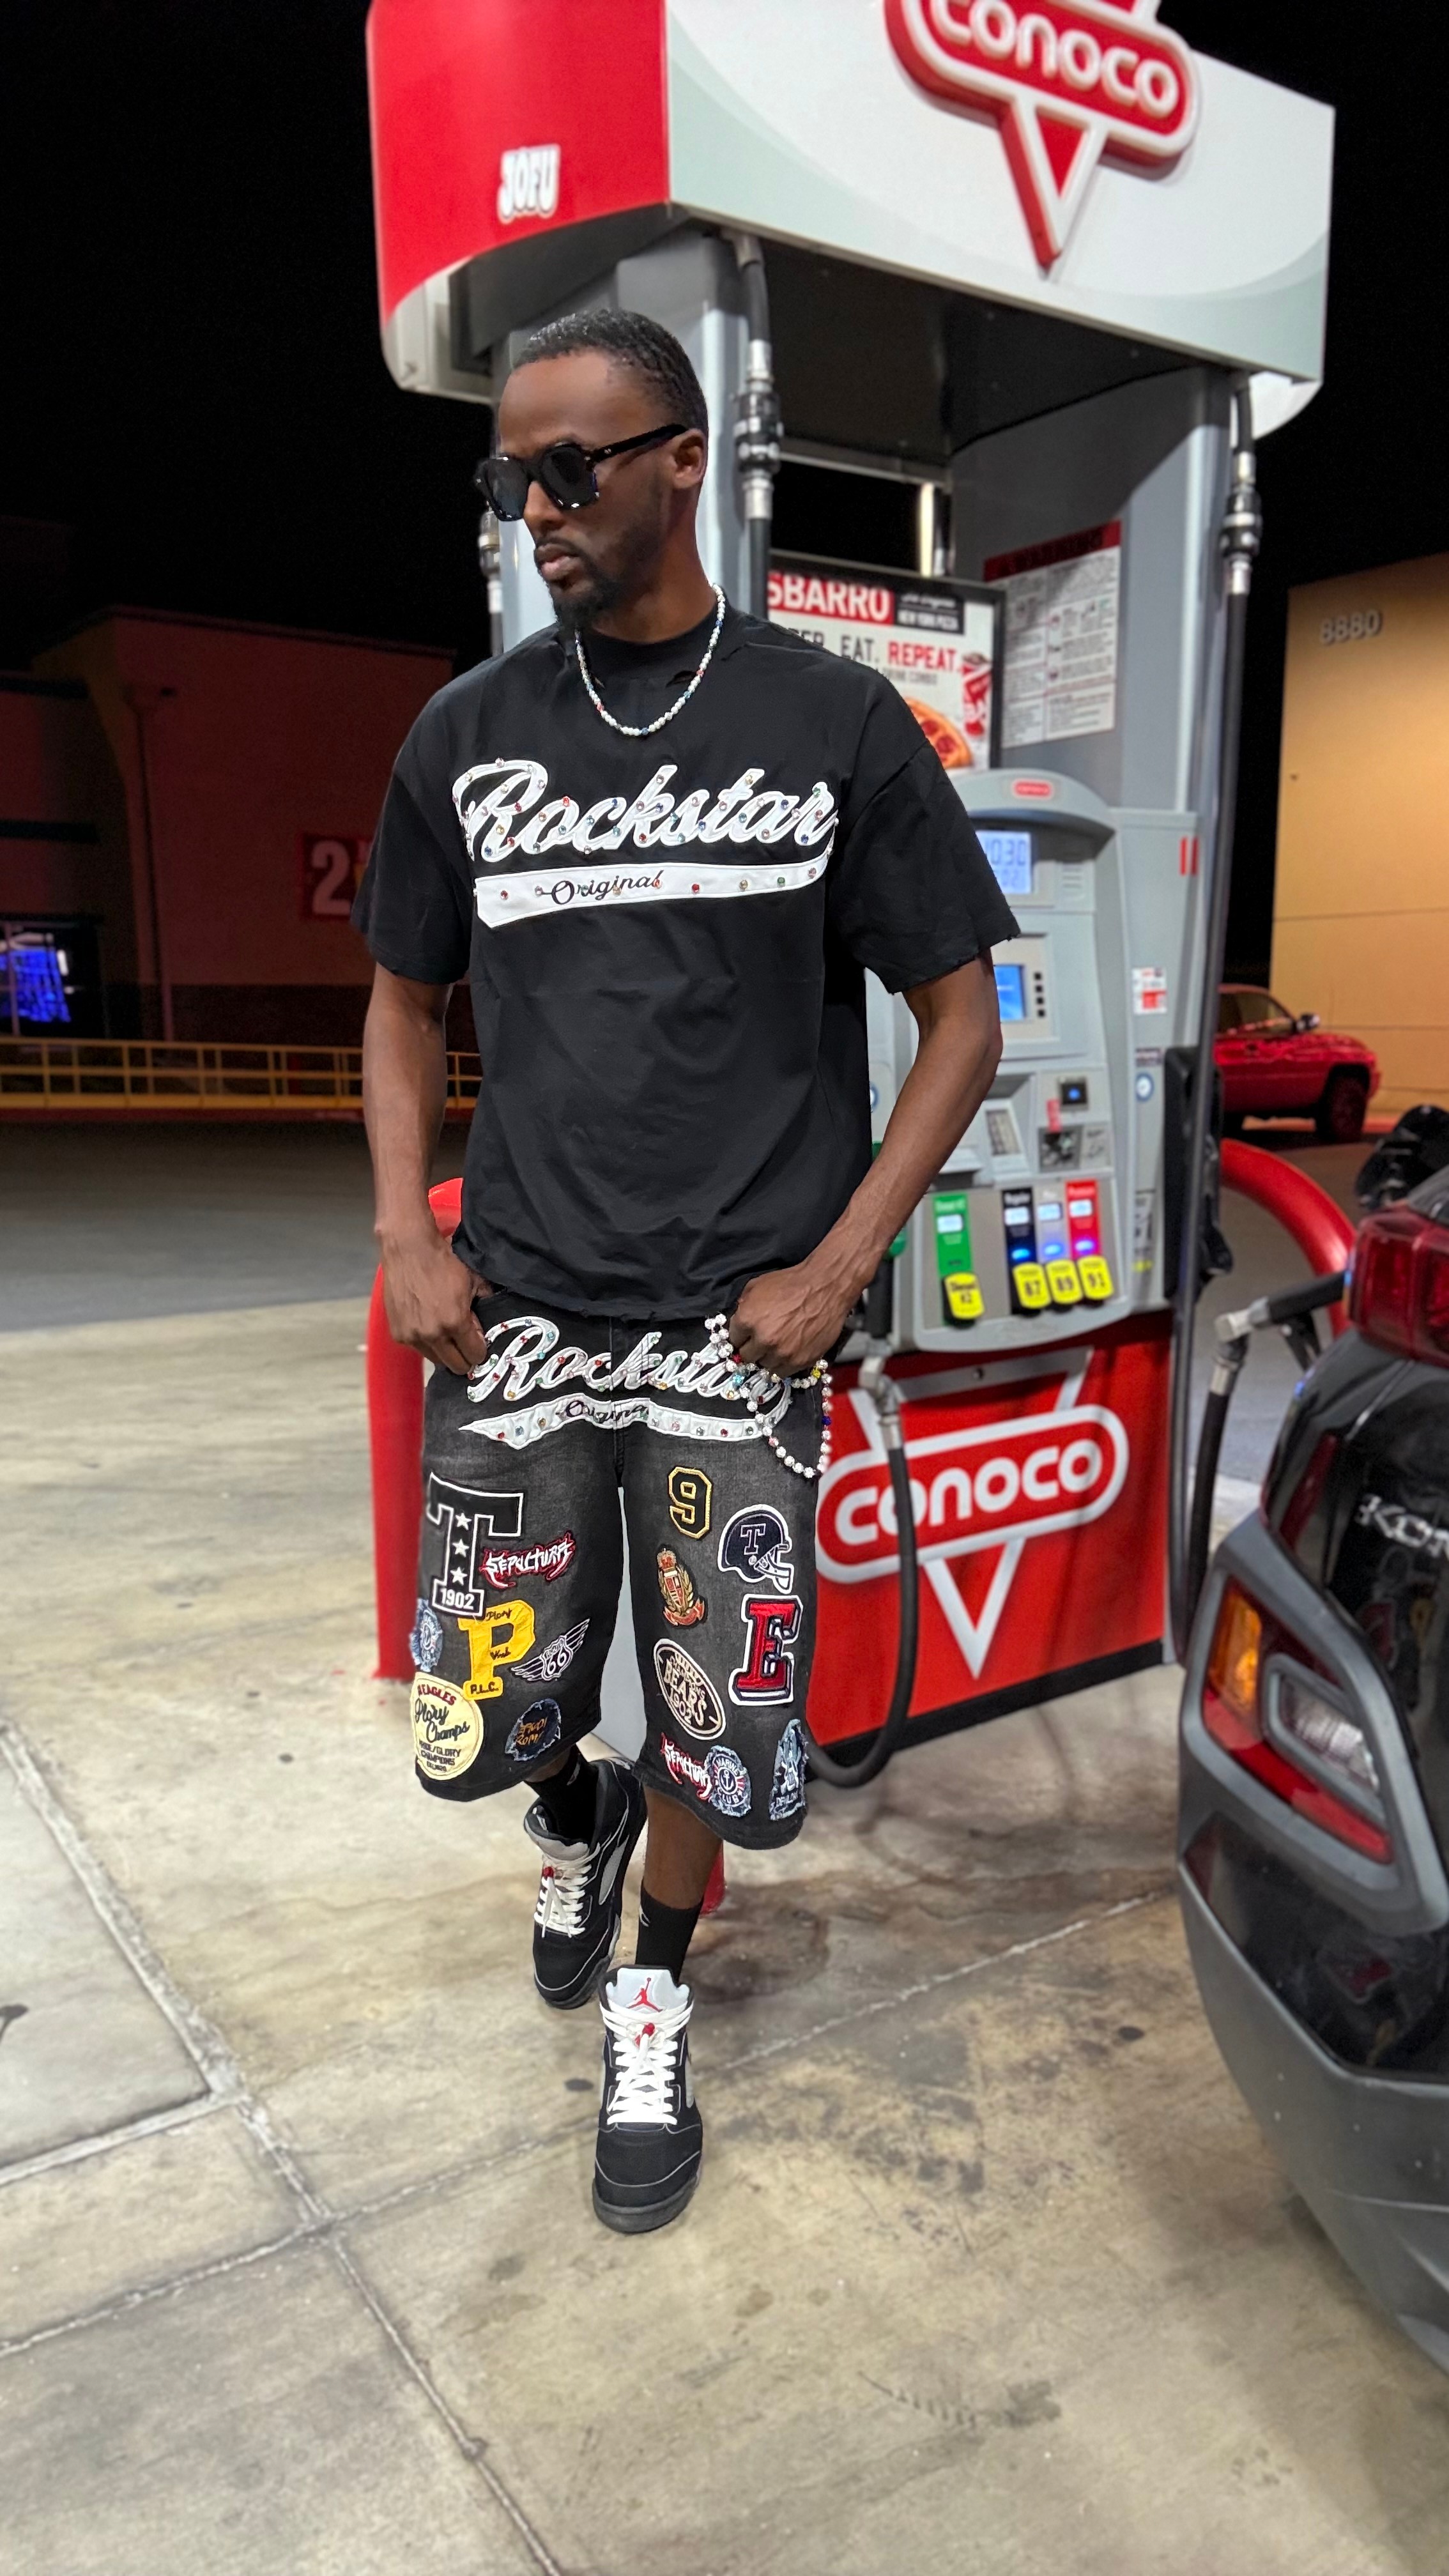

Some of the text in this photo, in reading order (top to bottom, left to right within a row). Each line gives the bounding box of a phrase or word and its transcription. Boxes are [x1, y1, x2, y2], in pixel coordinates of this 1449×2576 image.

[497, 144, 560, 224] JOFU
[768, 573, 891, 622] SBARRO
[1319, 610, 1382, 646] 8880
[452, 758, 836, 862] Rockstar
[311, 839, 351, 916] 2
[540, 870, 664, 905] Original
[1024, 1280, 1041, 1298] 87
[1087, 1273, 1105, 1288] 91
[668, 1466, 712, 1539] 9
[426, 1472, 524, 1618] T
[740, 1522, 767, 1556] T
[439, 1588, 475, 1610] 1902
[457, 1600, 535, 1701] P
[547, 1646, 574, 1675] 66
[732, 1596, 801, 1705] E
[663, 1658, 707, 1727] BEARS
[669, 1685, 692, 1725] 1902
[716, 1757, 740, 1776] MARINE
[717, 1786, 740, 1804] CLUB
